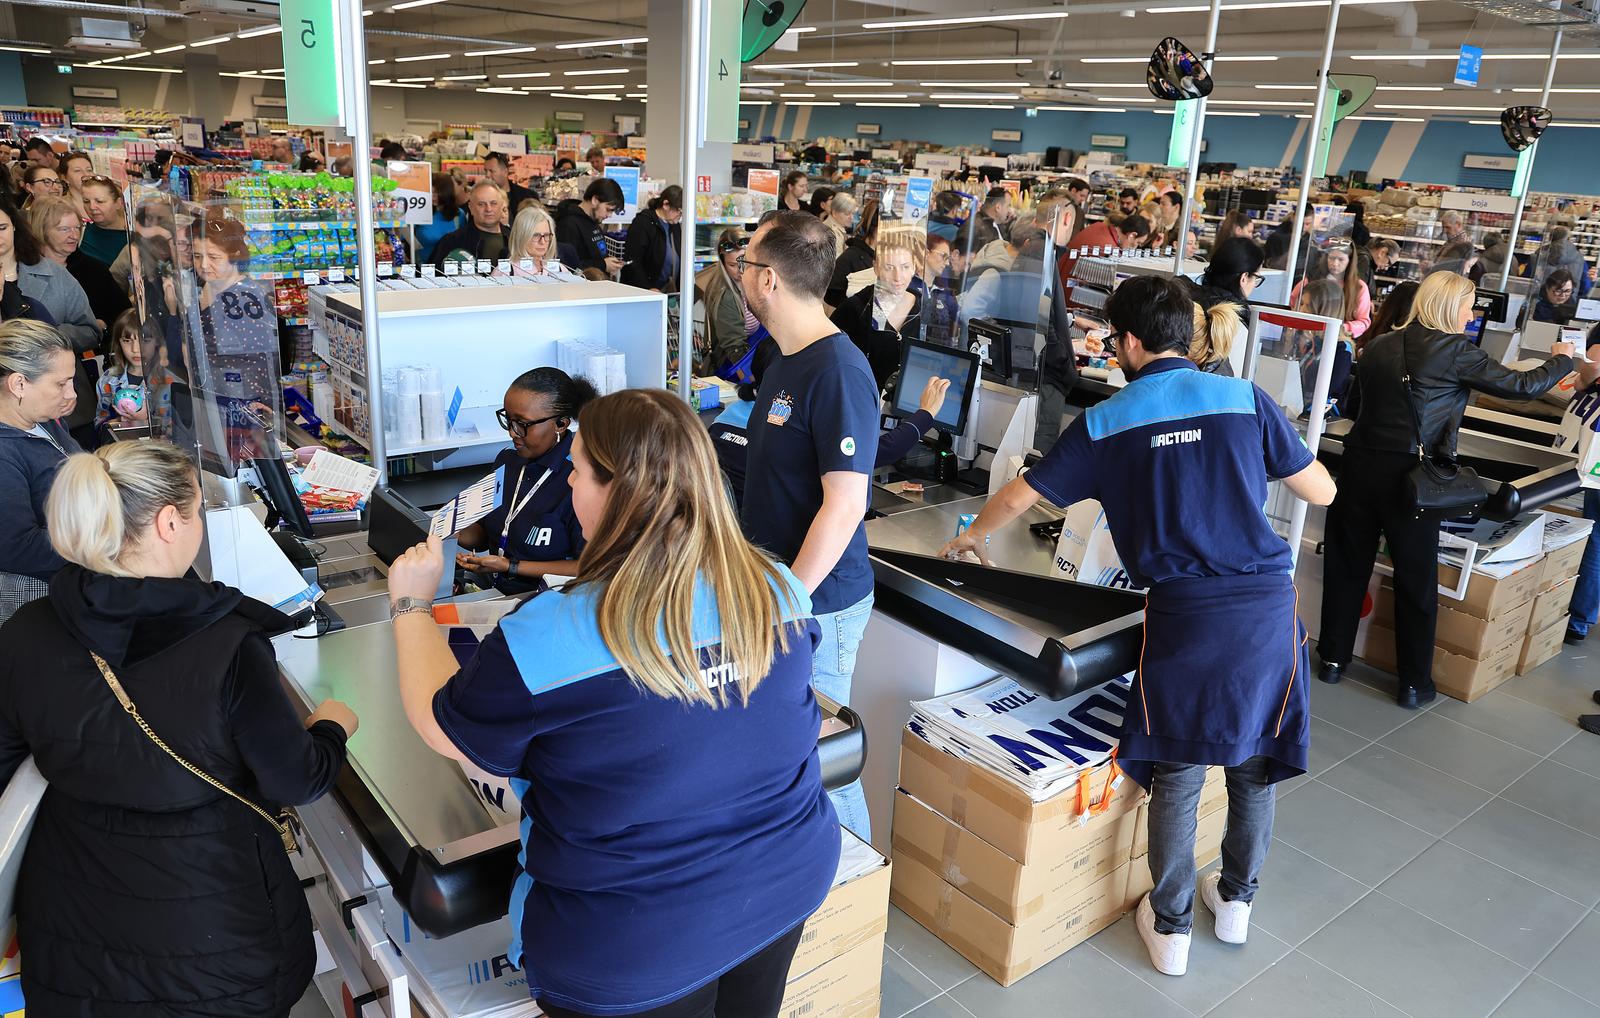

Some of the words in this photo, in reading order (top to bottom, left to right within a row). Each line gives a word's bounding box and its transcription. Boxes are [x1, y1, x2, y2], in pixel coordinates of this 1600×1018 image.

[1471, 199, 1488, 208] boja
[722, 432, 749, 446] ACTION
[1157, 428, 1202, 447] ACTION
[535, 527, 552, 546] A
[985, 689, 1040, 715] TION
